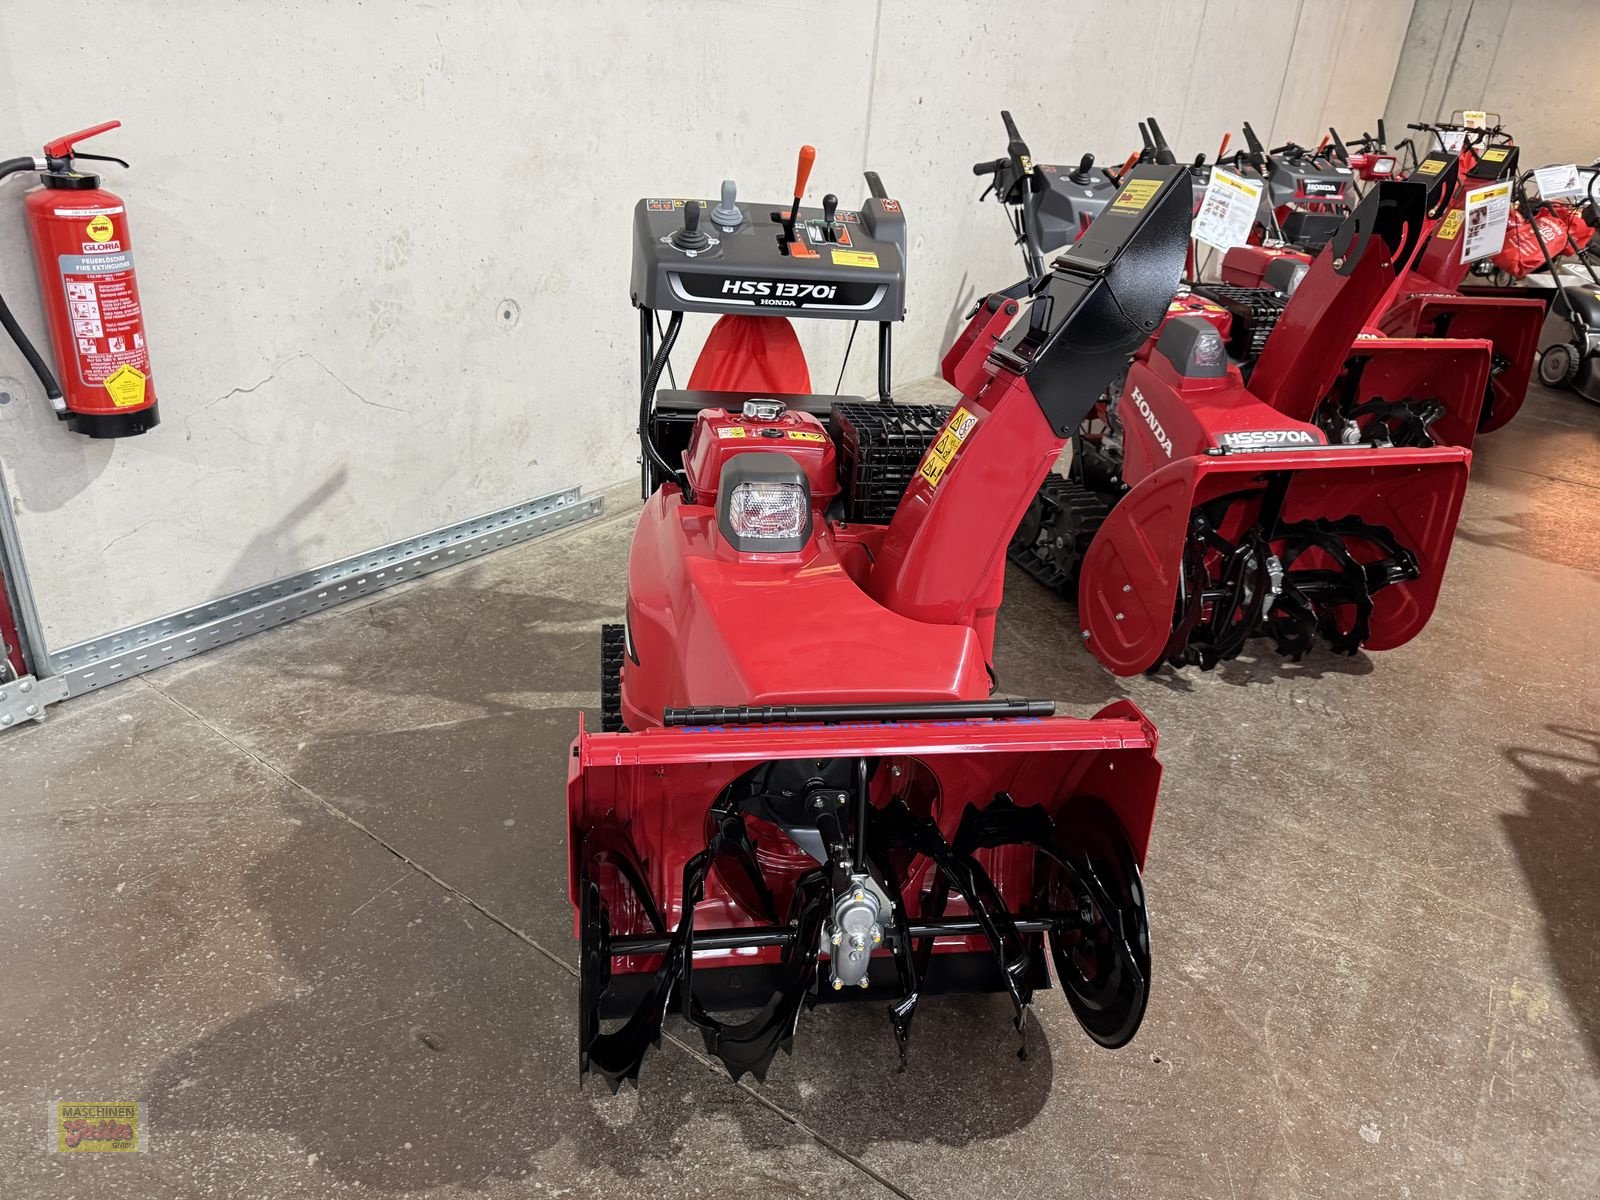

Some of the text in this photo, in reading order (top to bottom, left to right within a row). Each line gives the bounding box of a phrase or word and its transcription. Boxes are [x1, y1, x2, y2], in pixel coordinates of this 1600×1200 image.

[1306, 184, 1337, 192] HONDA
[84, 243, 120, 252] GLORIA
[75, 260, 131, 272] FIRE EXTINGUISHER
[721, 279, 838, 299] HSS 1370i
[760, 298, 797, 307] HONDA
[1130, 386, 1174, 459] HONDA
[1224, 430, 1314, 446] HSS970A
